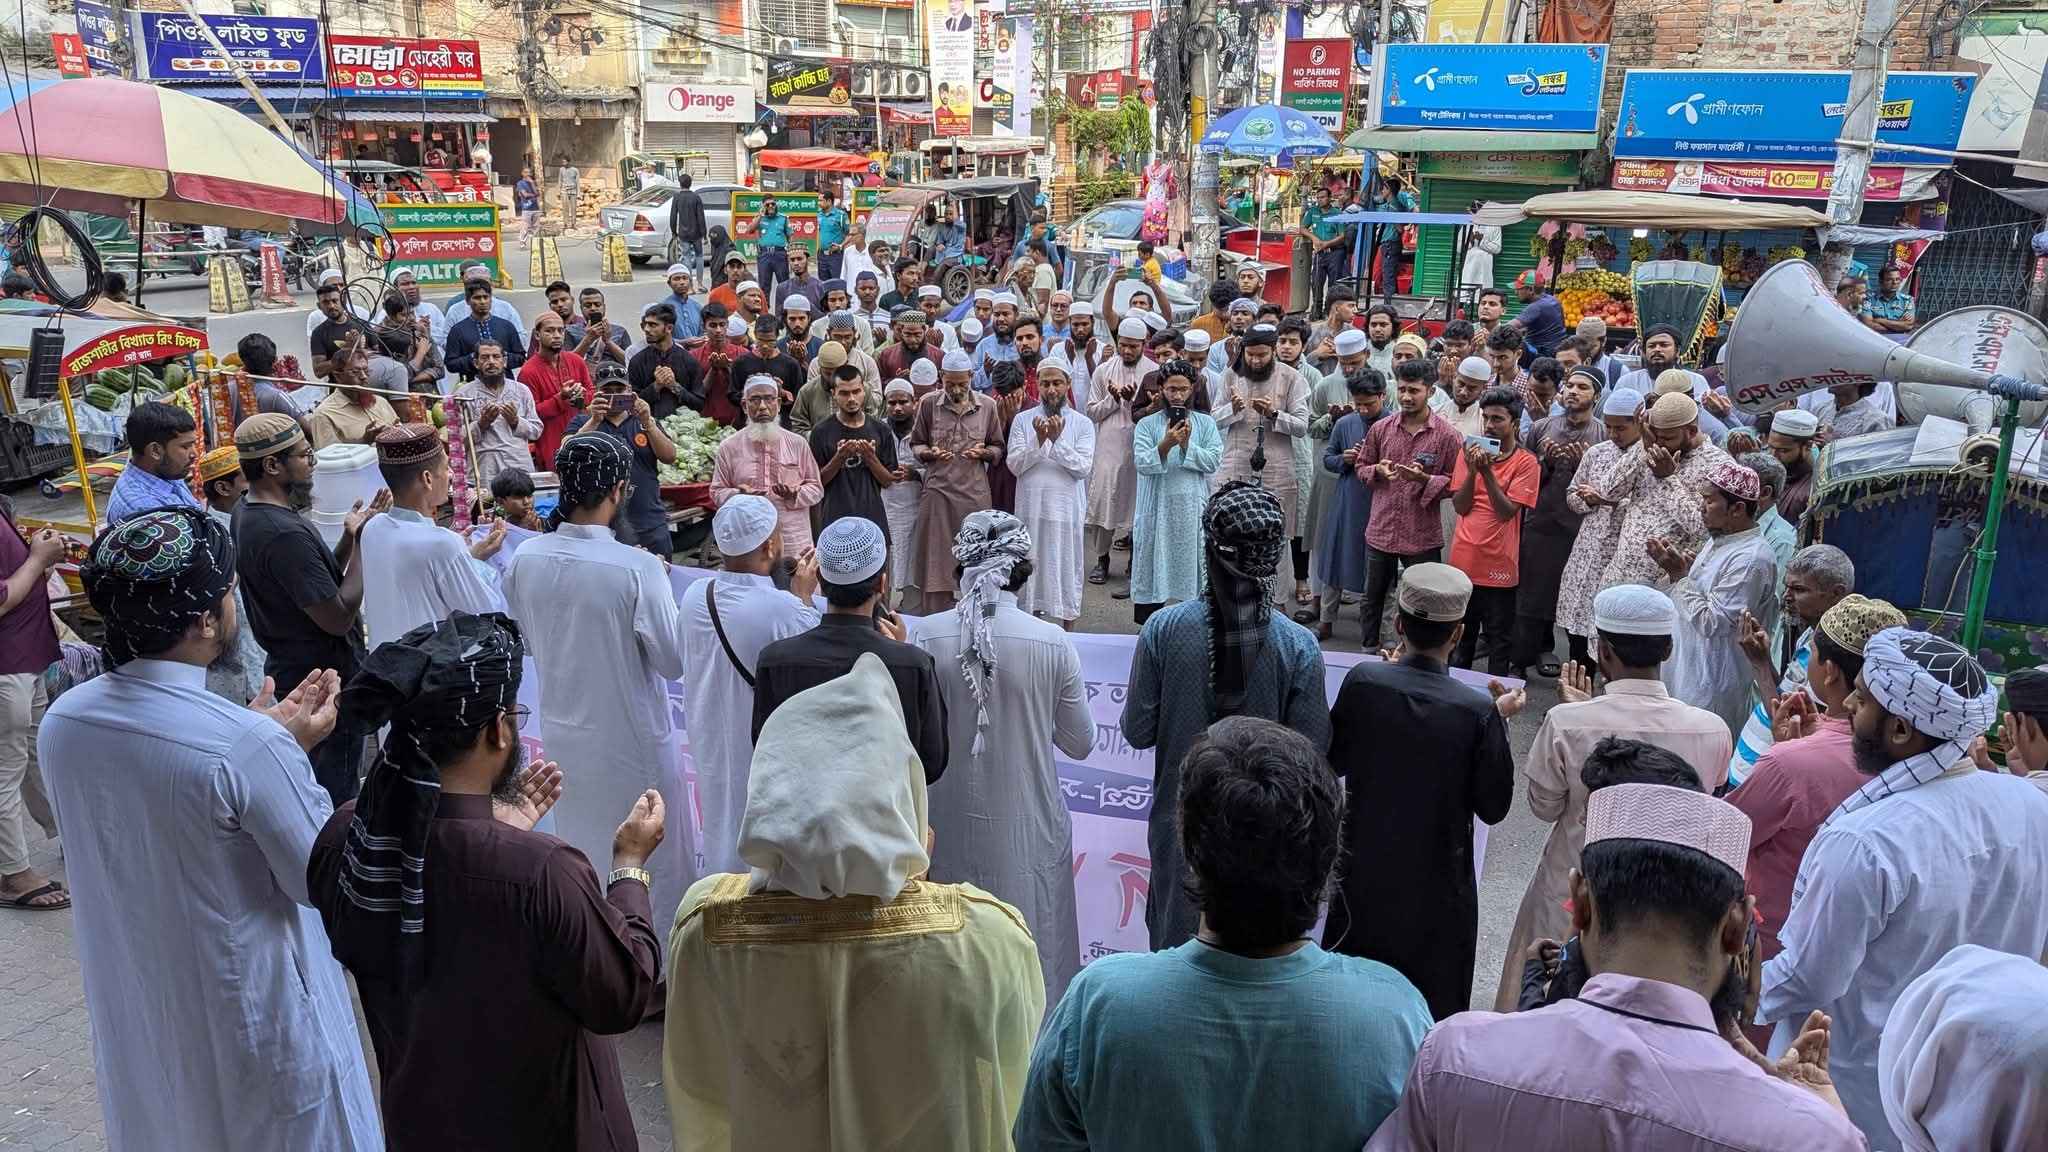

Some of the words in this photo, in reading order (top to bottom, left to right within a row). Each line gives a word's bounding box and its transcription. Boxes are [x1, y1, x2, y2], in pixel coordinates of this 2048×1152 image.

[215, 21, 271, 44] লাইভ
[272, 27, 307, 48] ফুড
[333, 44, 405, 71] মোল্লা
[455, 51, 474, 68] ঘর
[1293, 68, 1305, 76] NO
[1306, 68, 1341, 76] PARKING
[1701, 100, 1764, 117] গ্রামীণফোন
[402, 237, 428, 255] পুলিশ
[431, 237, 476, 252] চেকপোস্ট
[68, 339, 119, 374] রাজশাহীর
[119, 333, 155, 350] বিখ্যাত
[157, 331, 173, 345] রিং
[174, 331, 201, 350] চিপস
